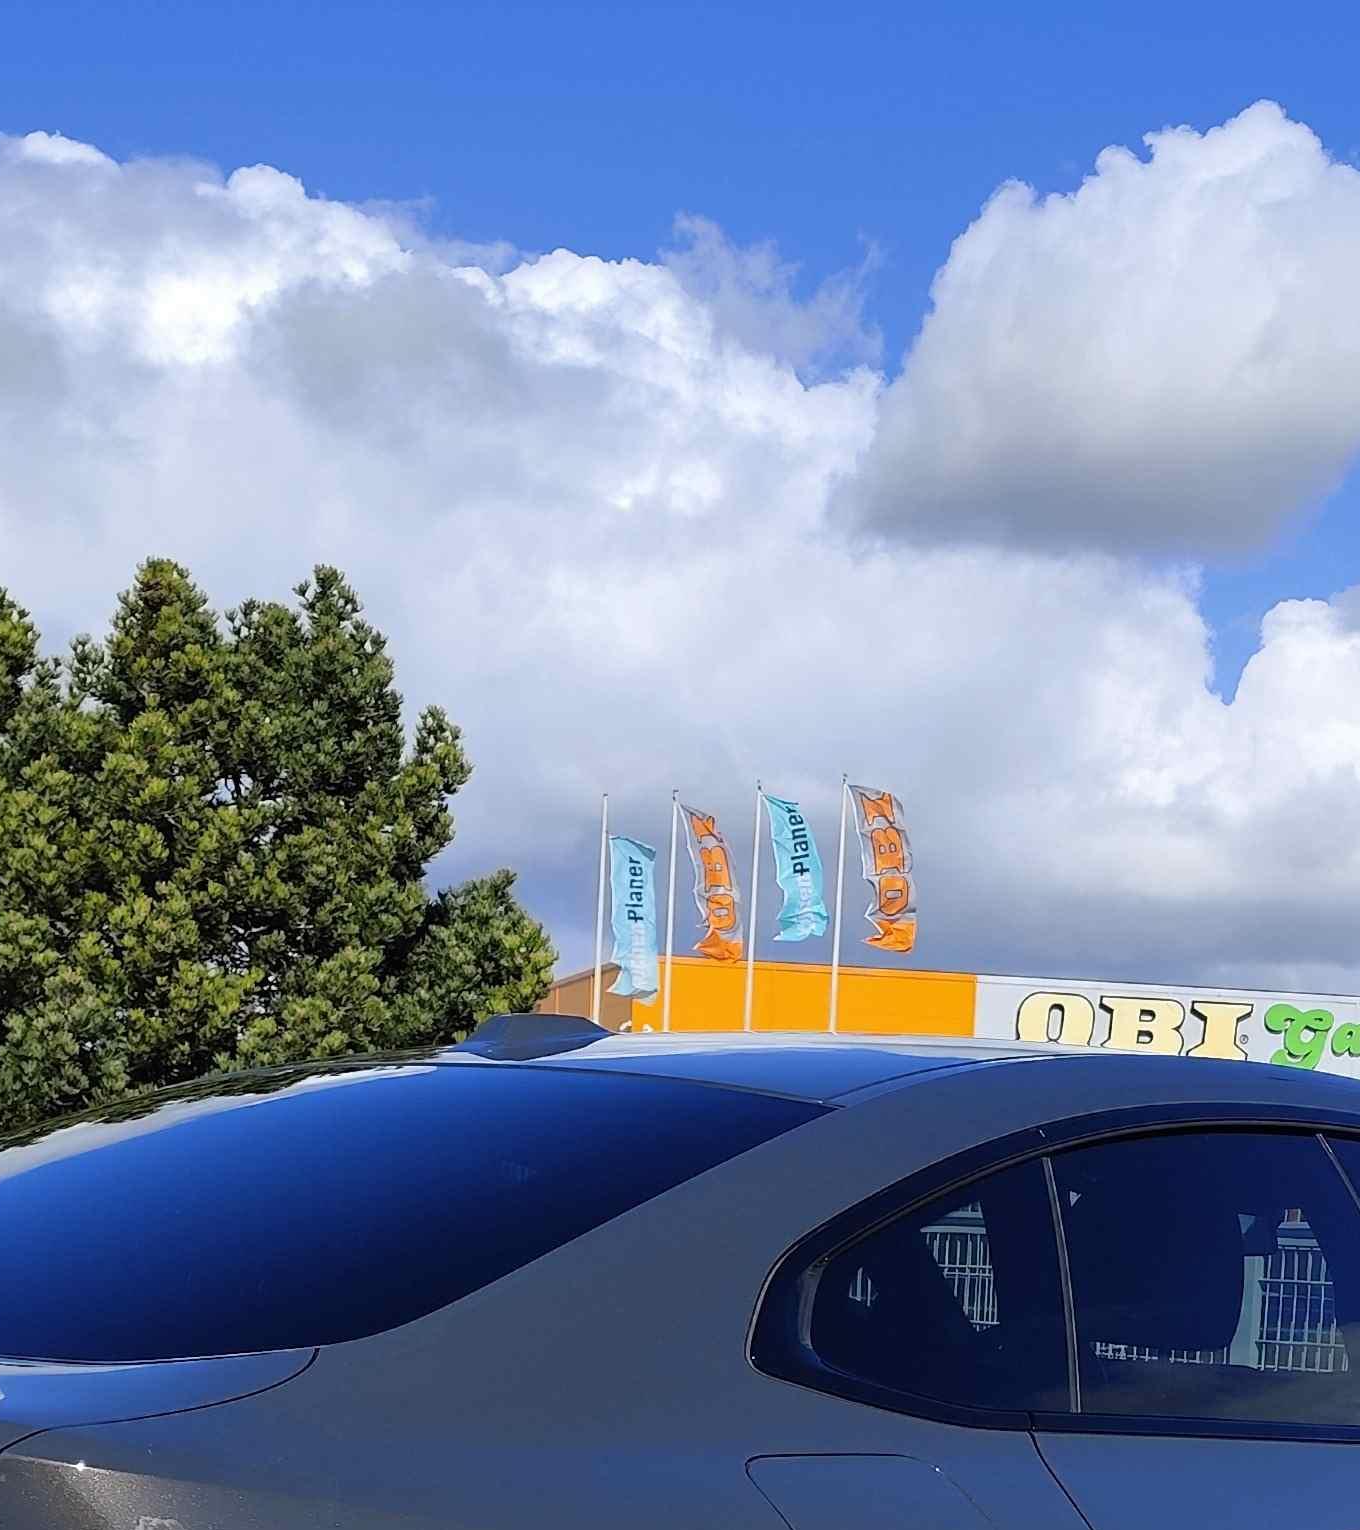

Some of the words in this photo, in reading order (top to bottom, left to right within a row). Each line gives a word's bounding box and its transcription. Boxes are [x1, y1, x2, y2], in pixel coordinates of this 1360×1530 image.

[691, 815, 737, 932] OBI
[783, 802, 811, 877] Planer
[860, 791, 908, 916] OBI
[625, 856, 645, 923] Planer
[1016, 991, 1254, 1061] OBI
